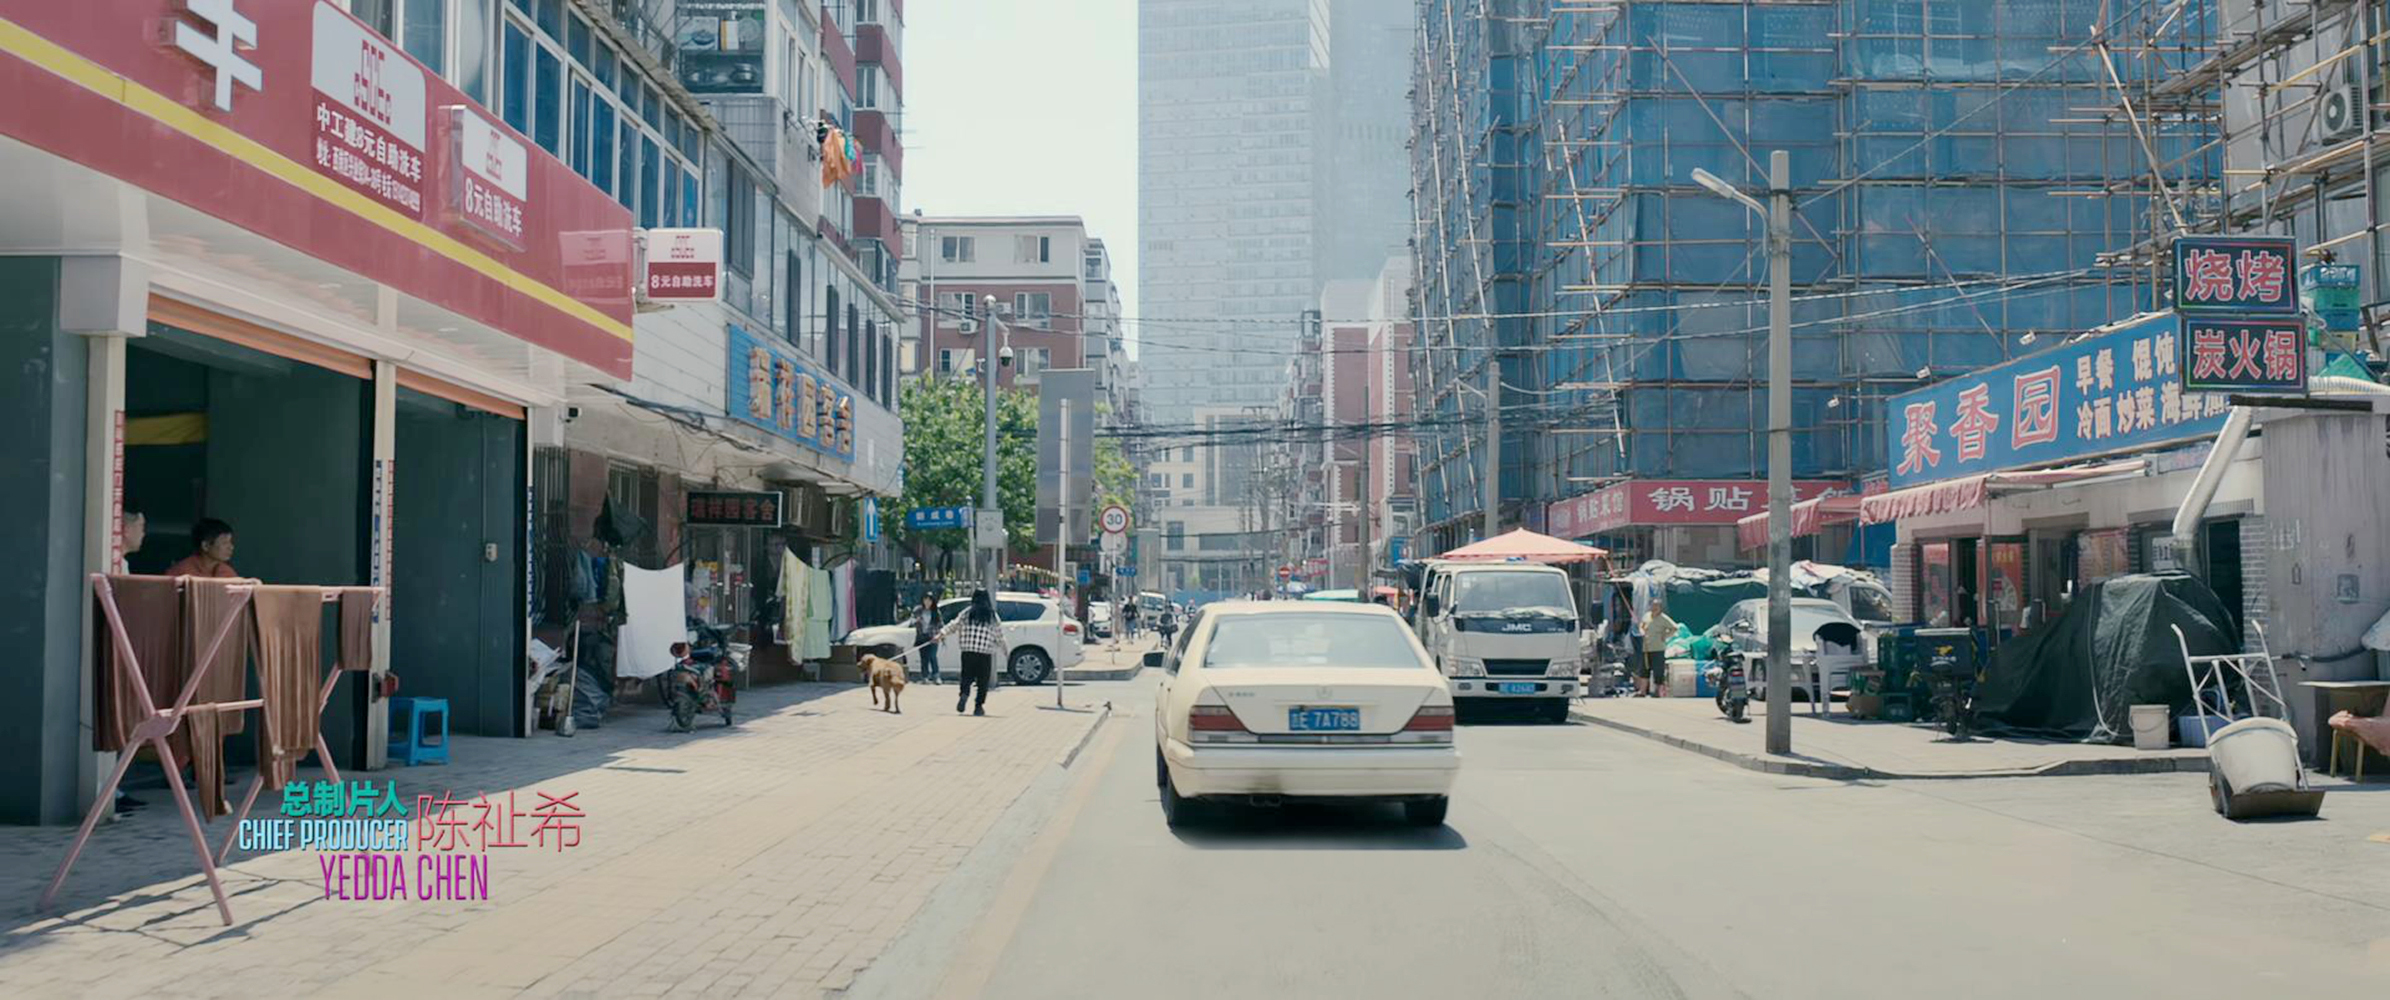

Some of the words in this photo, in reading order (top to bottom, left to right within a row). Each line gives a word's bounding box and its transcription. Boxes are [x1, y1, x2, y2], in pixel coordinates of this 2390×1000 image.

[465, 178, 522, 238] 8元自助洗车
[650, 274, 714, 289] 8元自助洗车
[2185, 248, 2284, 302] 烧烤
[2076, 348, 2115, 396] 早餐
[2193, 328, 2298, 381] 炭火锅
[1896, 364, 2061, 477] 聚香园
[2077, 396, 2111, 440] 冷面
[2117, 386, 2156, 435] 炒菜
[1106, 513, 1123, 525] 30
[1501, 623, 1533, 632] JMC
